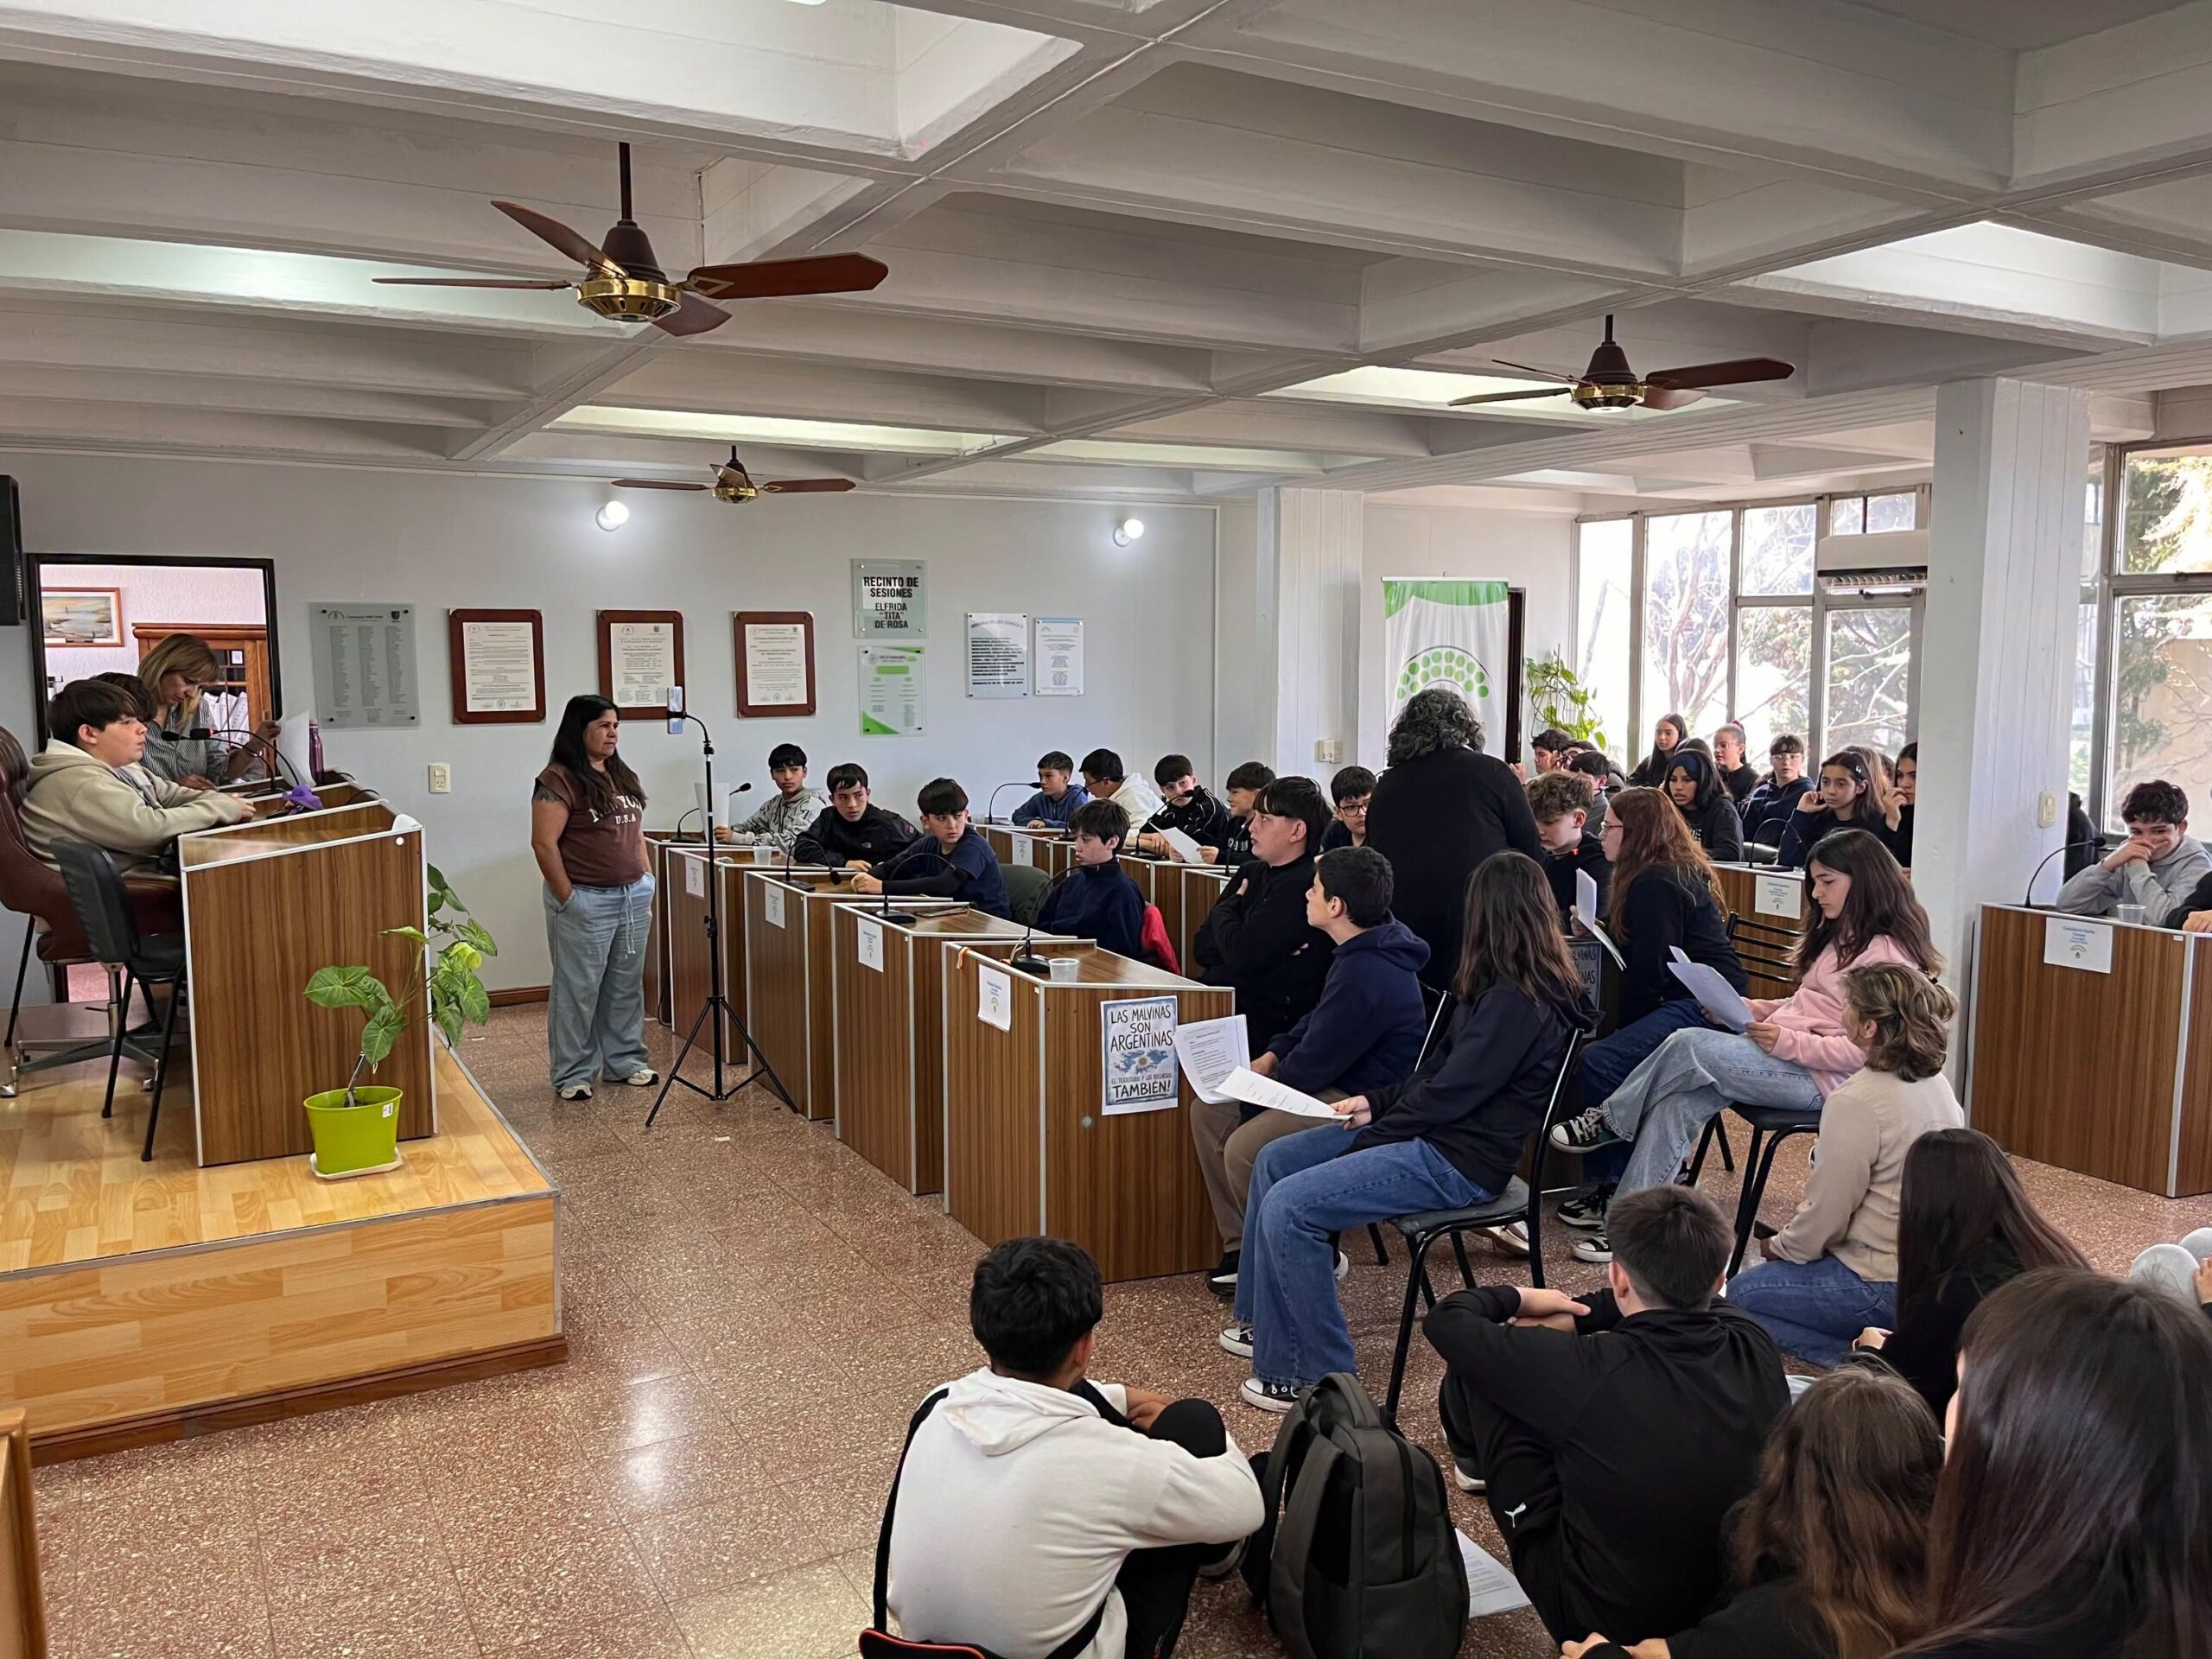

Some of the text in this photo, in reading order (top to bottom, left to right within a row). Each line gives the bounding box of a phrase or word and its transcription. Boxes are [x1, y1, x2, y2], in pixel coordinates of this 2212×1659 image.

[864, 576, 918, 588] RECINTO DE
[870, 588, 912, 598] SESIONES
[874, 620, 908, 629] DE ROSA
[1111, 1005, 1171, 1024] LAS MALVINAS
[1130, 1021, 1151, 1033] SON
[1110, 1030, 1173, 1052] ARGENTINAS
[1112, 1079, 1171, 1098] TAMBIÉN!
